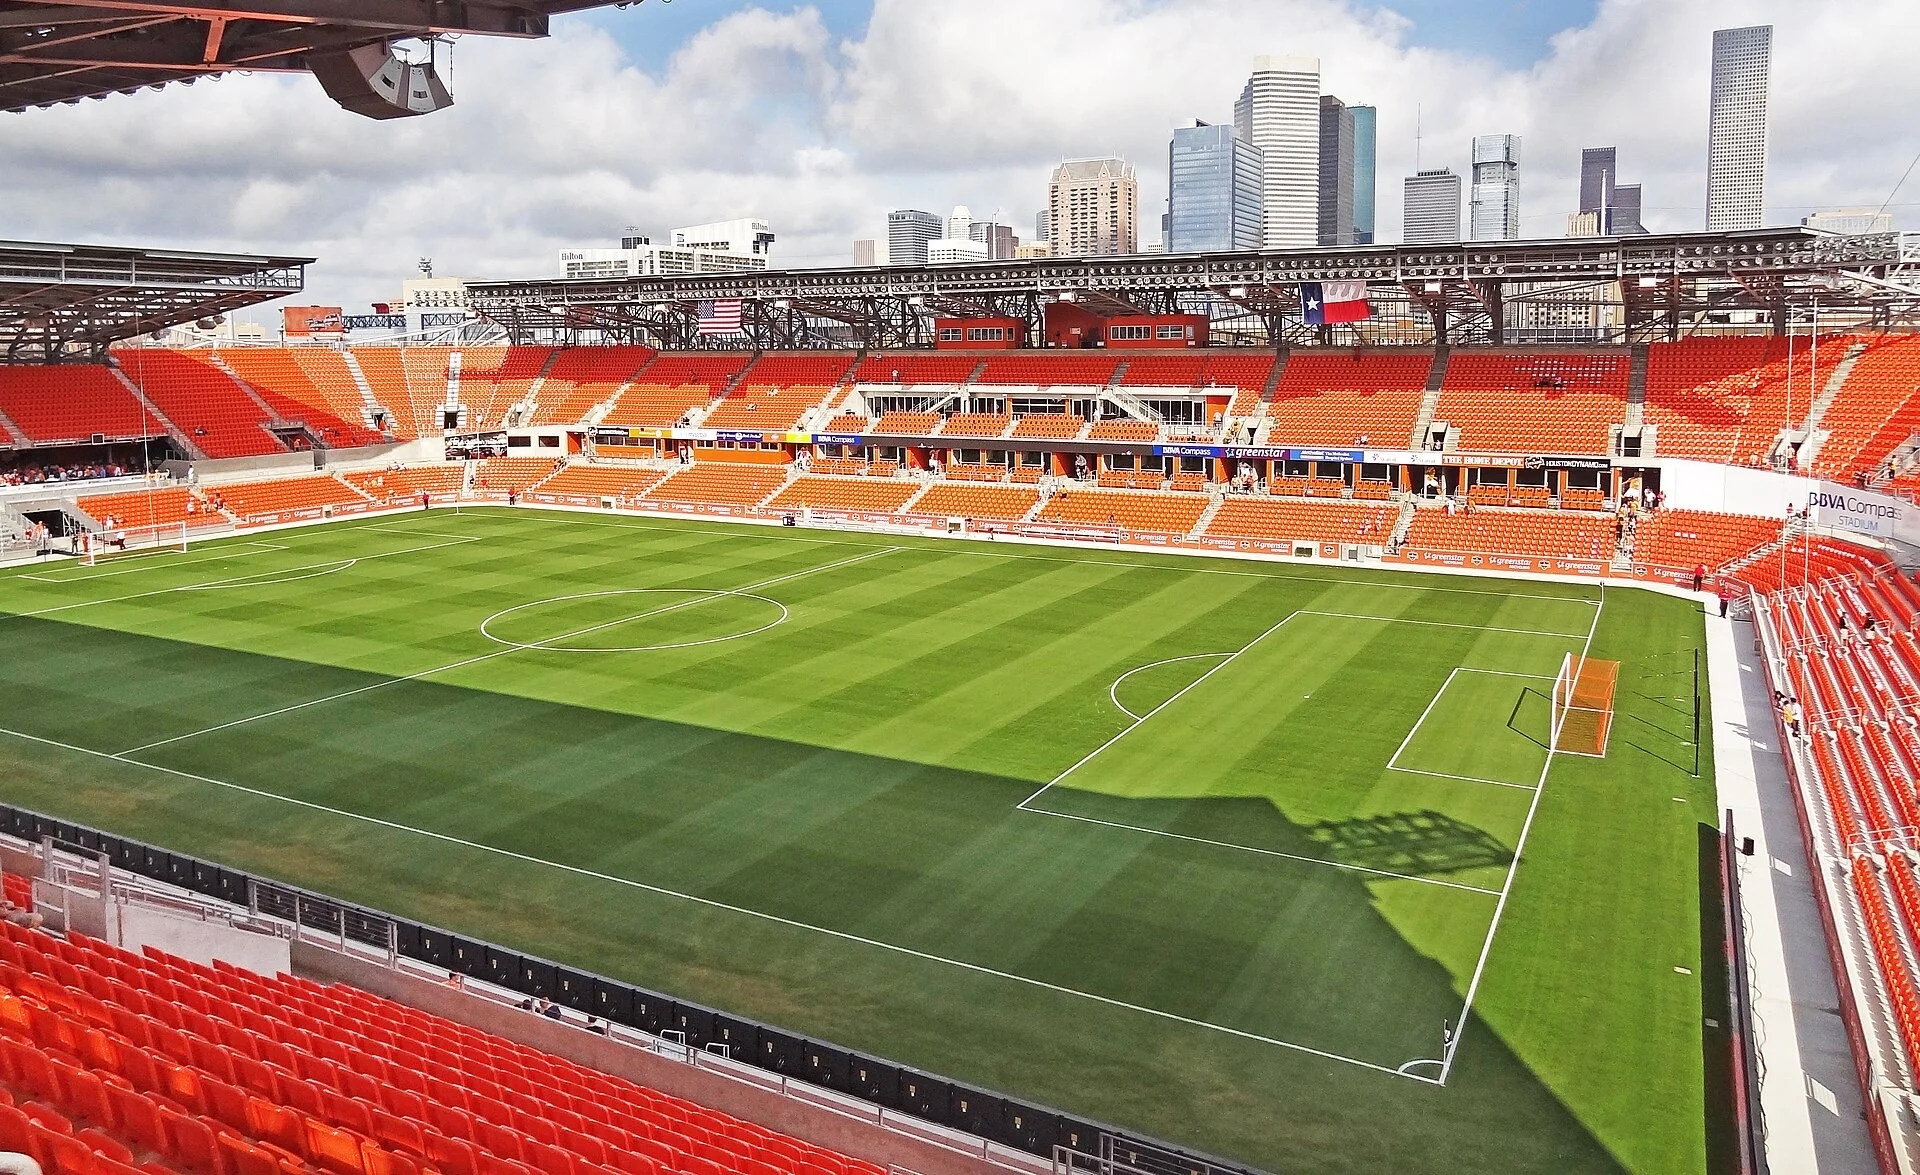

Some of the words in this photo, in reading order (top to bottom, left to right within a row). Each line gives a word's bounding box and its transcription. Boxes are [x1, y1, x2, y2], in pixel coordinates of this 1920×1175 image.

[752, 222, 769, 231] Hilton
[561, 252, 583, 261] Hilton
[817, 435, 831, 443] BBVA
[832, 436, 855, 444] Compass
[1162, 446, 1180, 454] BBVA
[1180, 447, 1211, 456] Compass
[1235, 448, 1285, 459] greenstar
[1443, 455, 1463, 465] THE
[1463, 456, 1491, 466] HOME
[1491, 457, 1524, 467] DEPOT
[1809, 491, 1846, 511] BBVA
[1847, 497, 1902, 521] Compass
[1838, 515, 1878, 531] STADIUM
[1431, 552, 1466, 562] greenstar
[1496, 558, 1532, 566] greenstar
[1564, 561, 1602, 571] greenstar
